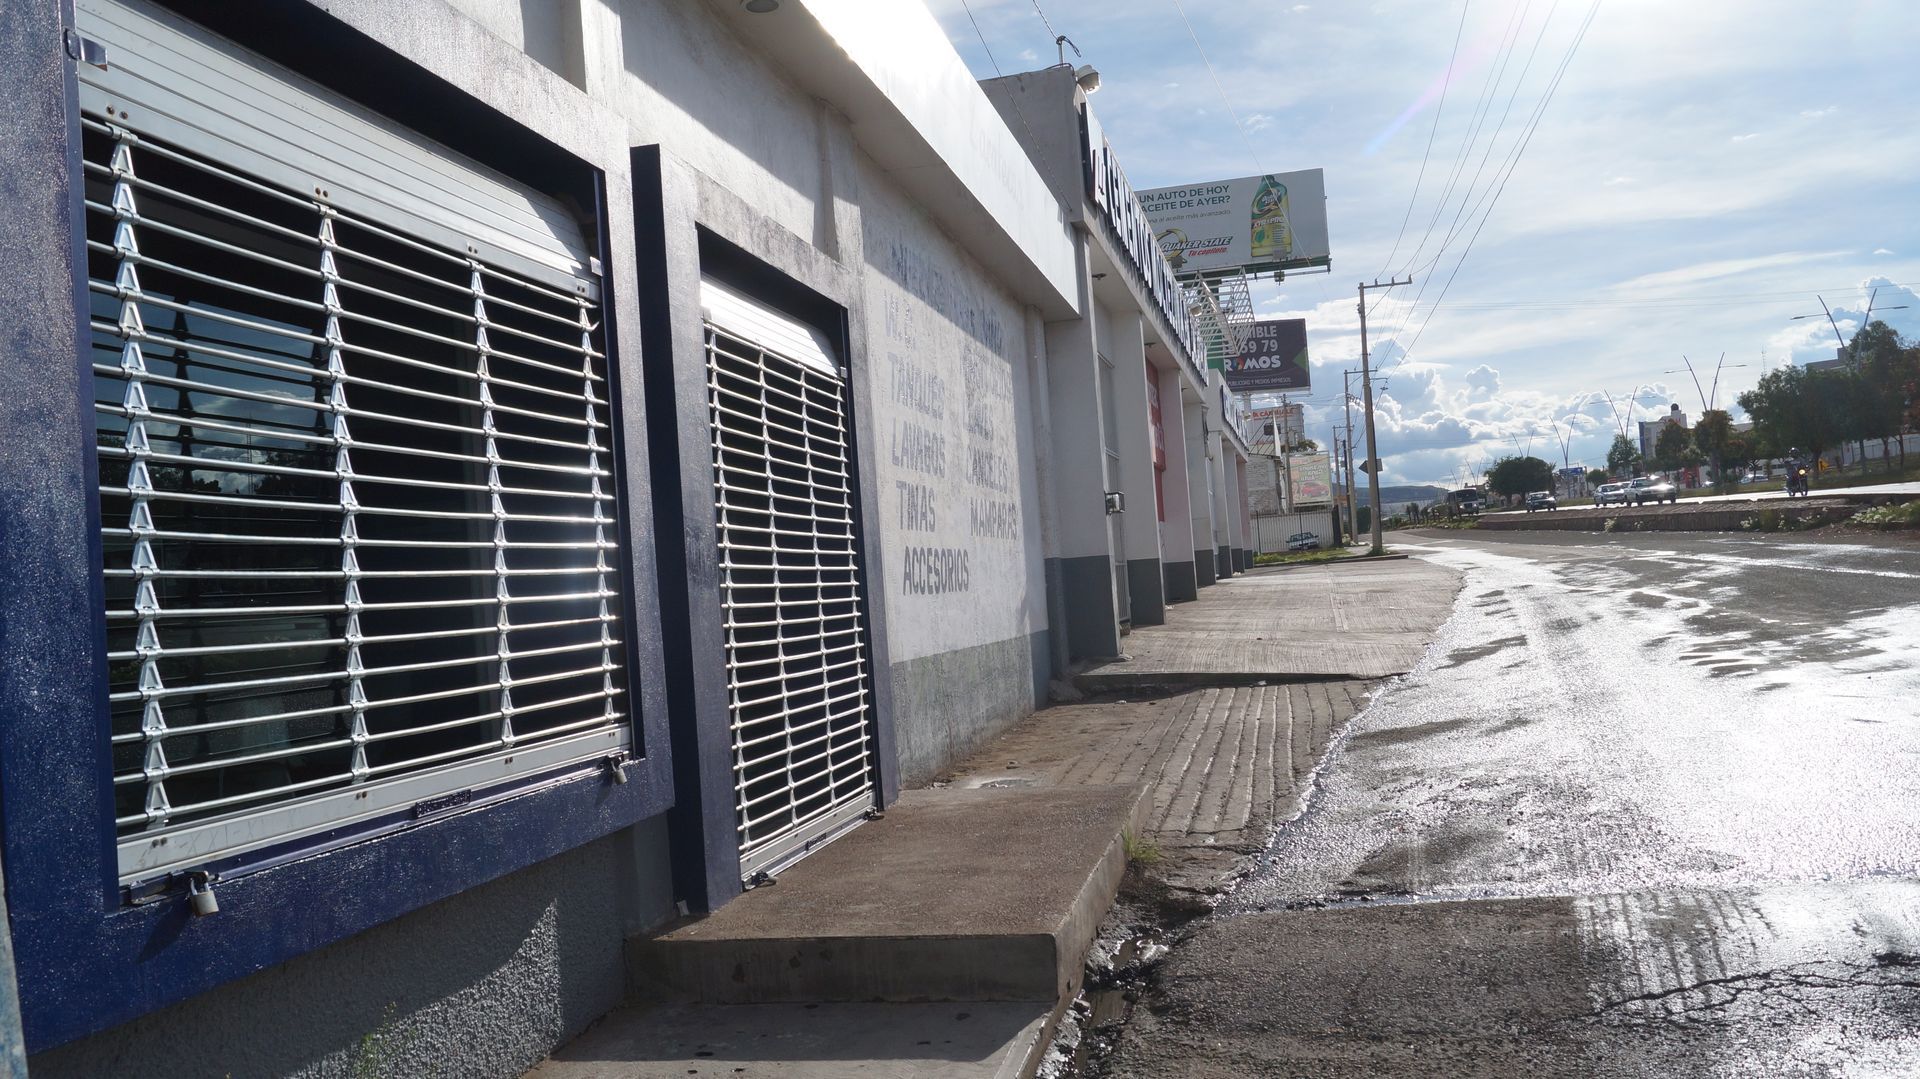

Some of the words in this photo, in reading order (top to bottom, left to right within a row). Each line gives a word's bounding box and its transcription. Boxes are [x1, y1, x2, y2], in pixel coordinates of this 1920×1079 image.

[1140, 194, 1154, 203] UN
[1157, 190, 1187, 201] AUTO
[1189, 187, 1204, 197] DE
[1206, 184, 1230, 195] HOY
[1141, 201, 1177, 213] ACEITE
[1180, 200, 1194, 209] DE
[1196, 195, 1231, 207] AYER?
[1165, 214, 1185, 222] aceite
[1186, 212, 1199, 220] más
[1200, 209, 1231, 218] avanzado
[1161, 239, 1201, 253] QUAKER
[1201, 235, 1233, 248] STATE
[1261, 339, 1278, 353] 79
[887, 351, 945, 421] TANQUES
[892, 416, 946, 479] LAVABOS
[966, 444, 1008, 495] CANCELES
[895, 480, 936, 533] TINAS
[970, 497, 1018, 540] MAMPARAS
[903, 545, 970, 596] ACCESORIOS
